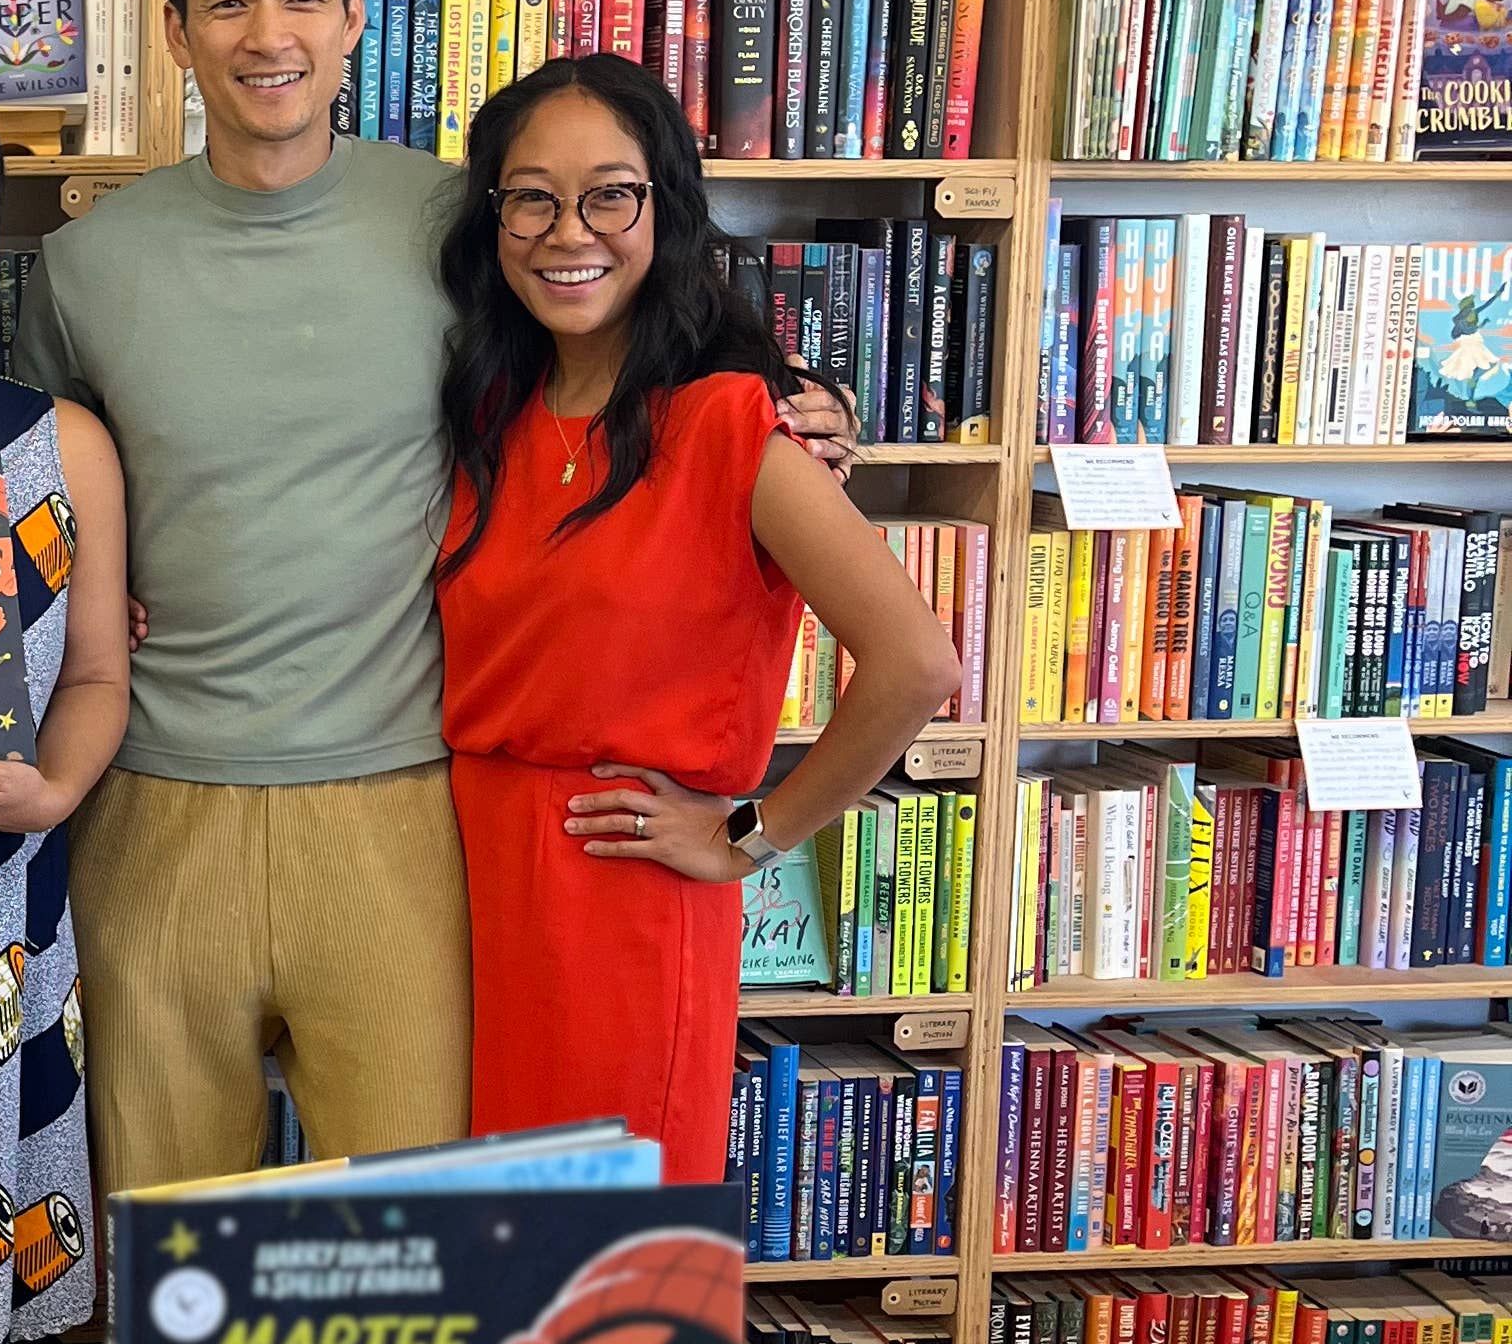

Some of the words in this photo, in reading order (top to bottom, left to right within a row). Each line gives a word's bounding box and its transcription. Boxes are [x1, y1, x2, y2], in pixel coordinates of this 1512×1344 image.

[733, 5, 767, 19] CITY
[16, 76, 80, 94] WILSON
[786, 67, 801, 129] BLADES
[1121, 229, 1140, 361] HULA
[1161, 550, 1170, 568] the
[1267, 512, 1292, 609] MAYUMU
[1156, 572, 1170, 615] MANGO
[1392, 567, 1409, 634] Philippines
[1153, 620, 1166, 653] TREE
[778, 1107, 789, 1141] THIEF
[776, 1145, 787, 1173] LIAR
[775, 1177, 786, 1207] LADY
